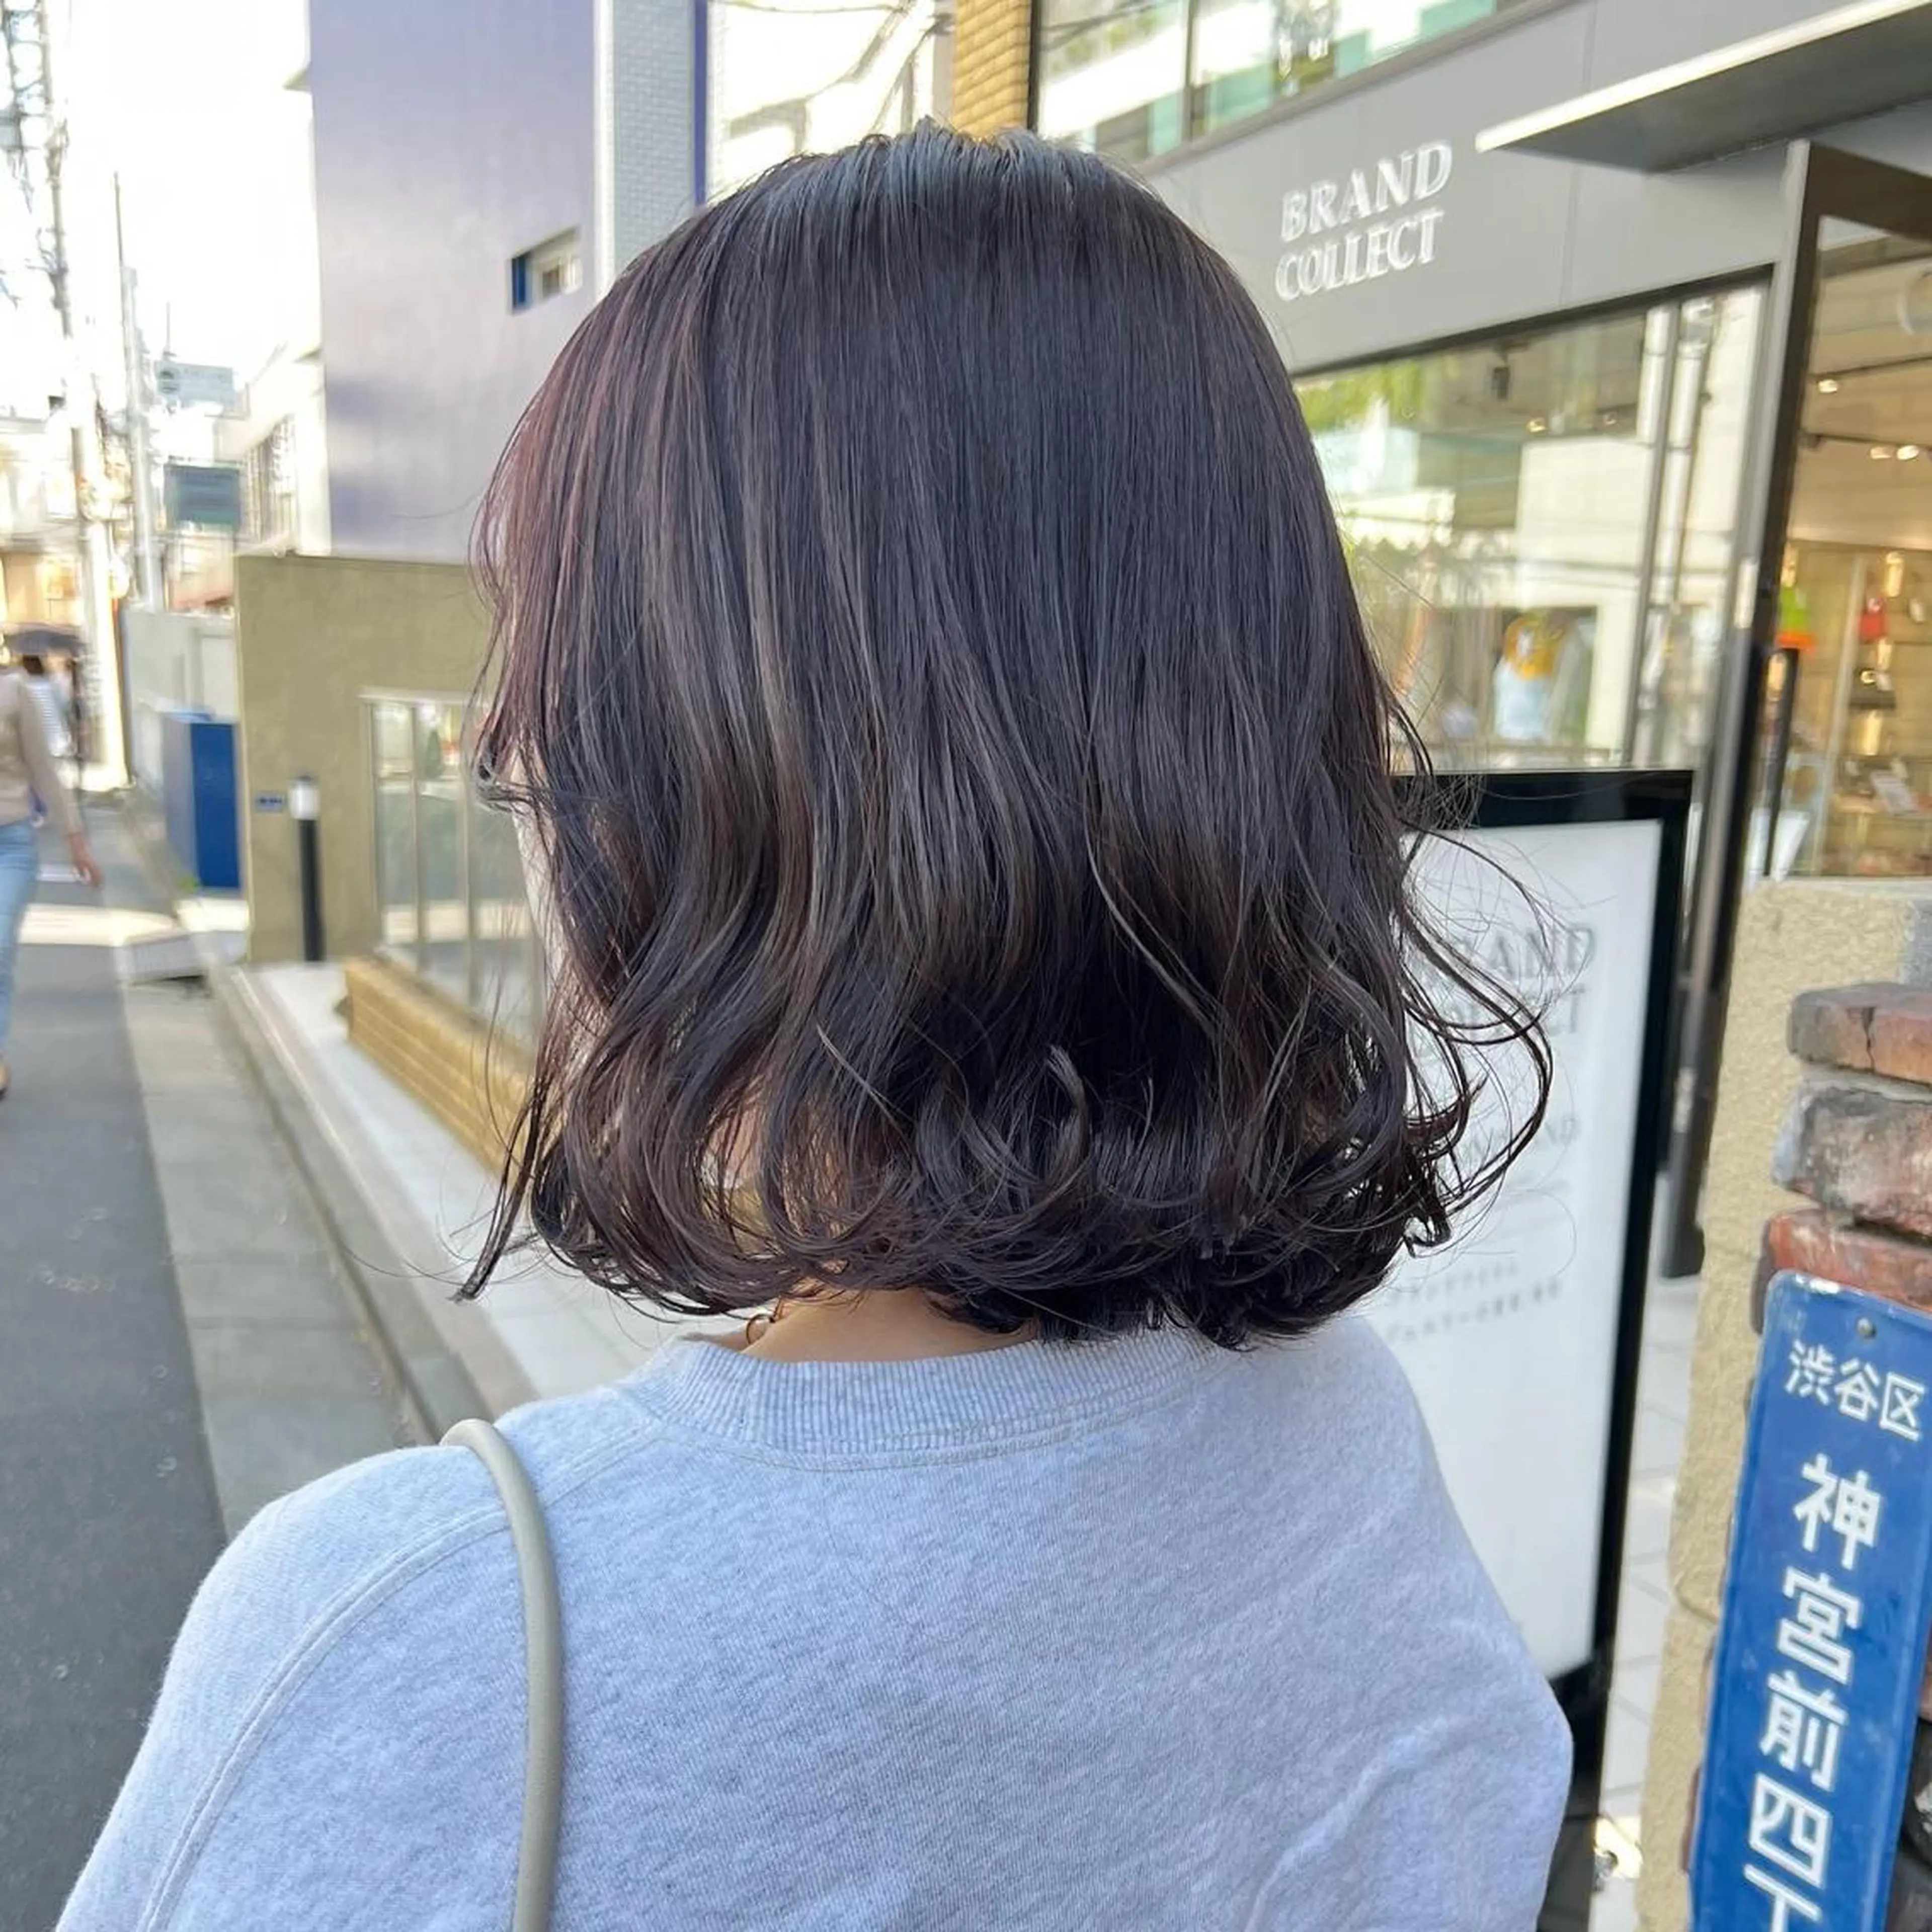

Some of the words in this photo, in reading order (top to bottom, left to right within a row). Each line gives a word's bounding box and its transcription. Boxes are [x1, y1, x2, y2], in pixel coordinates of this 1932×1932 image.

[1280, 140, 1453, 242] BRAND
[1275, 208, 1444, 302] COLLECT
[1785, 1339, 1925, 1441] 渋谷区
